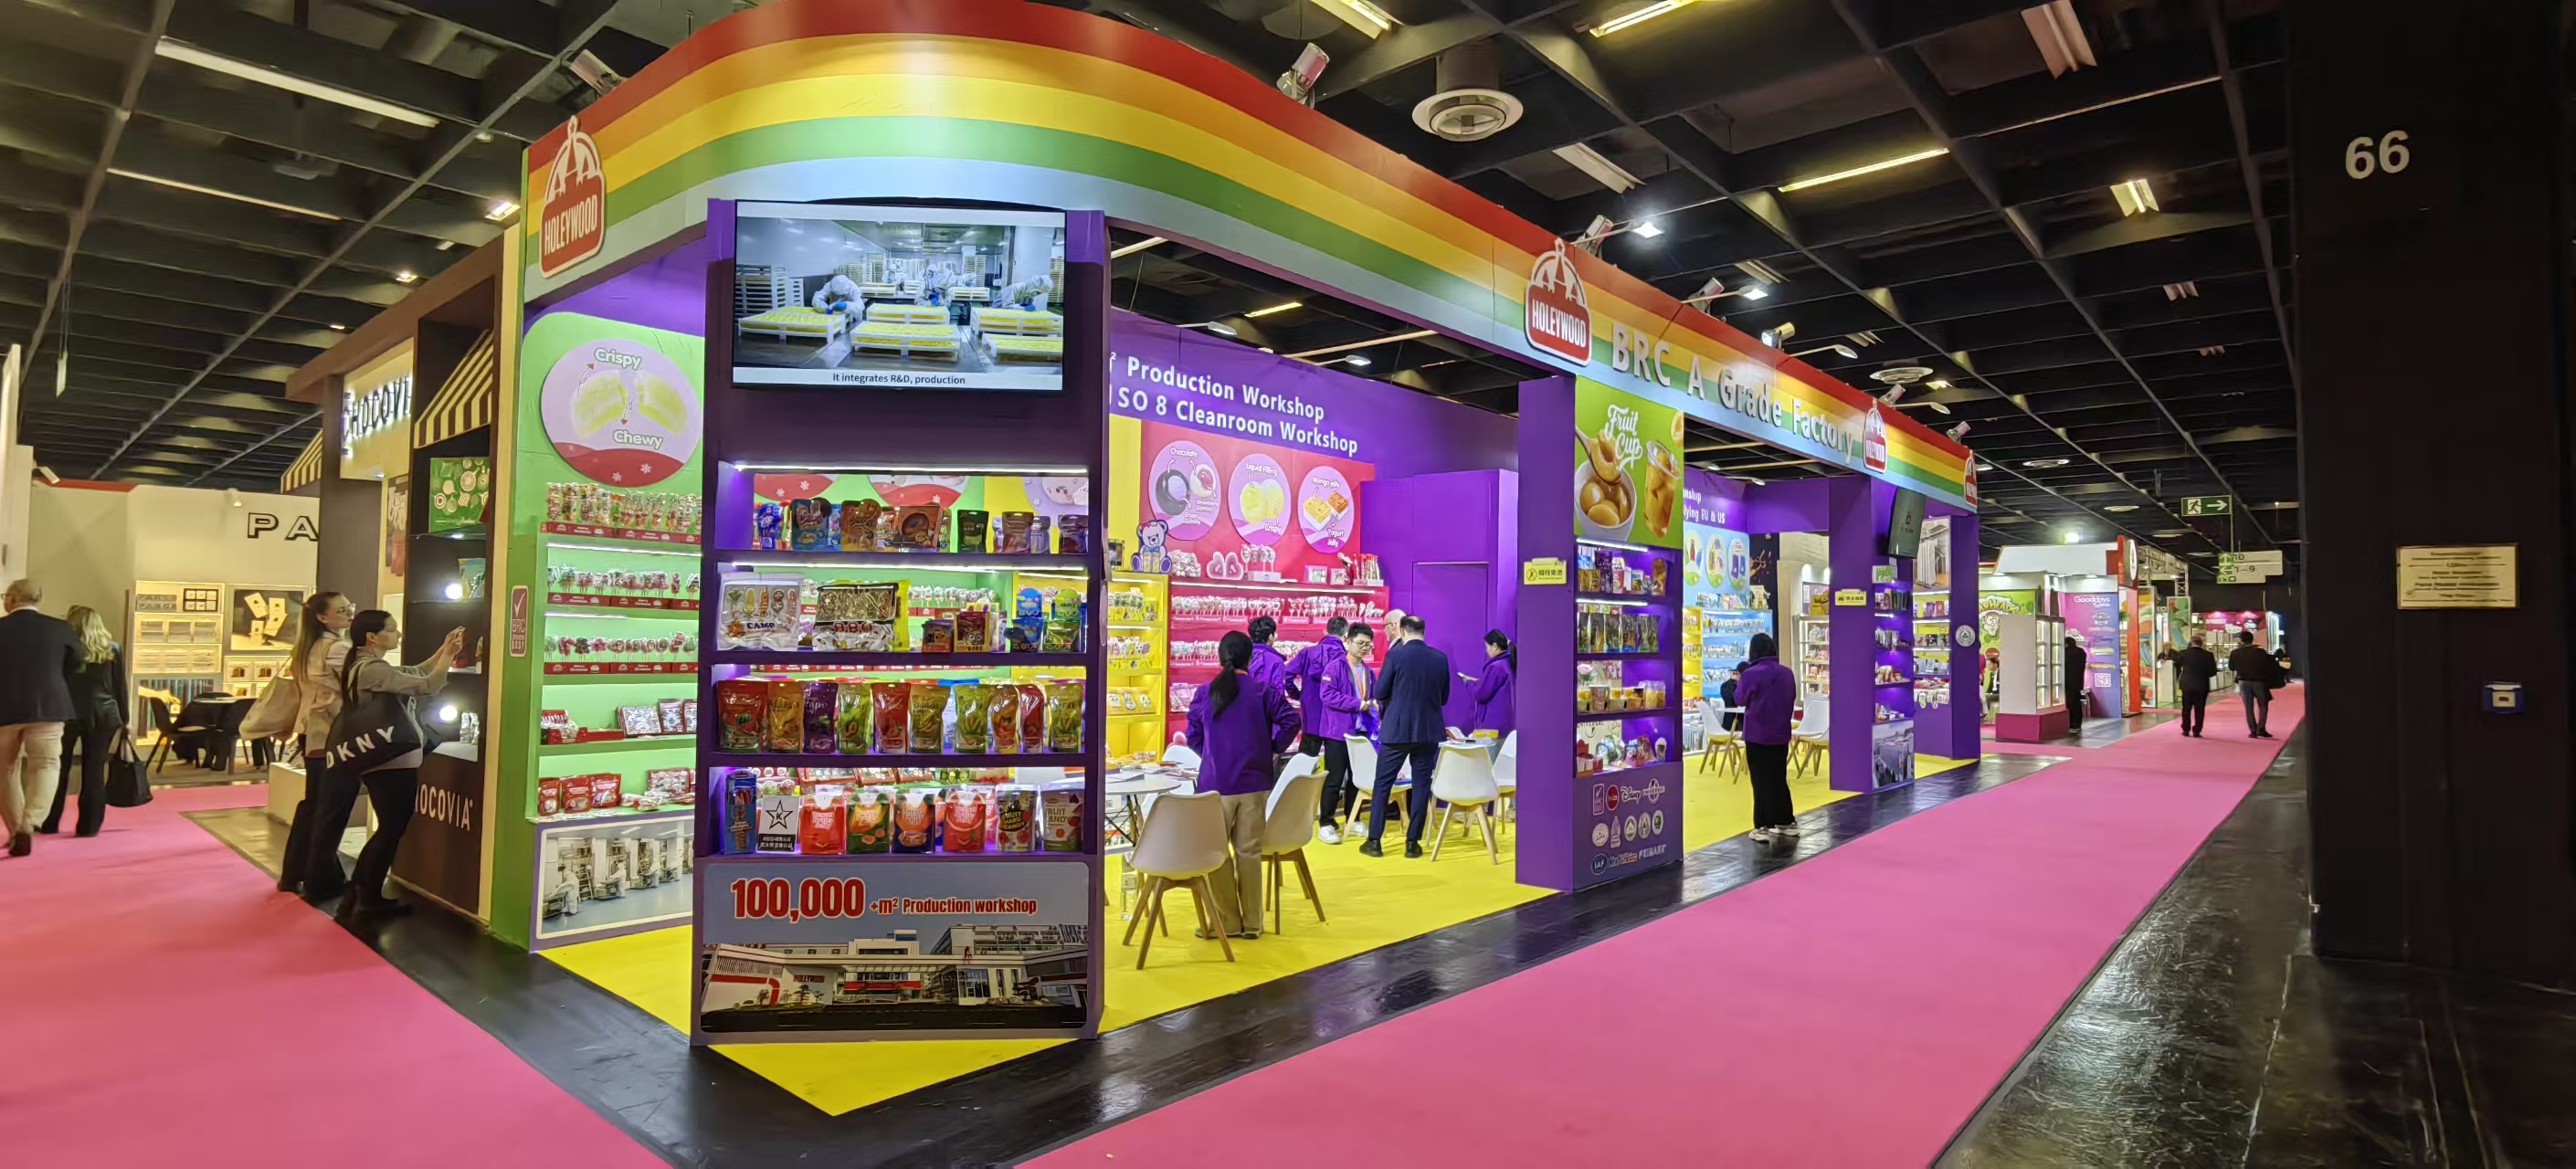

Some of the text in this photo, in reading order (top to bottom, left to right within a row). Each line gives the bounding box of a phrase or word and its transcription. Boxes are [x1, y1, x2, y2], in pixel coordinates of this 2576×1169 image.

[2346, 130, 2410, 179] 66
[544, 195, 597, 256] HOLEYWOOD
[1532, 299, 1586, 348] HOLEYWOOD
[594, 347, 642, 370] Crispy
[833, 373, 966, 384] It integrates R&D, production
[1127, 355, 1234, 400] Production
[1242, 384, 1325, 423] Workshop
[1611, 321, 1853, 464] BRC A Grade Factory
[613, 428, 663, 449] Chewy
[1156, 395, 1167, 416] 8
[1176, 400, 1272, 437] Cleanroom
[1280, 420, 1357, 457] Workshop
[1605, 404, 1640, 439] Fruit
[1170, 448, 1198, 458] Chocolate
[1614, 433, 1643, 471] Cup
[247, 511, 320, 542] PA
[1264, 523, 1282, 534] Crispy
[325, 726, 395, 769] DKNY
[415, 784, 470, 831] OCOVIA
[776, 812, 783, 821] K
[731, 877, 866, 923] 100,000
[903, 897, 972, 914] Production
[975, 897, 1038, 916] workshop
